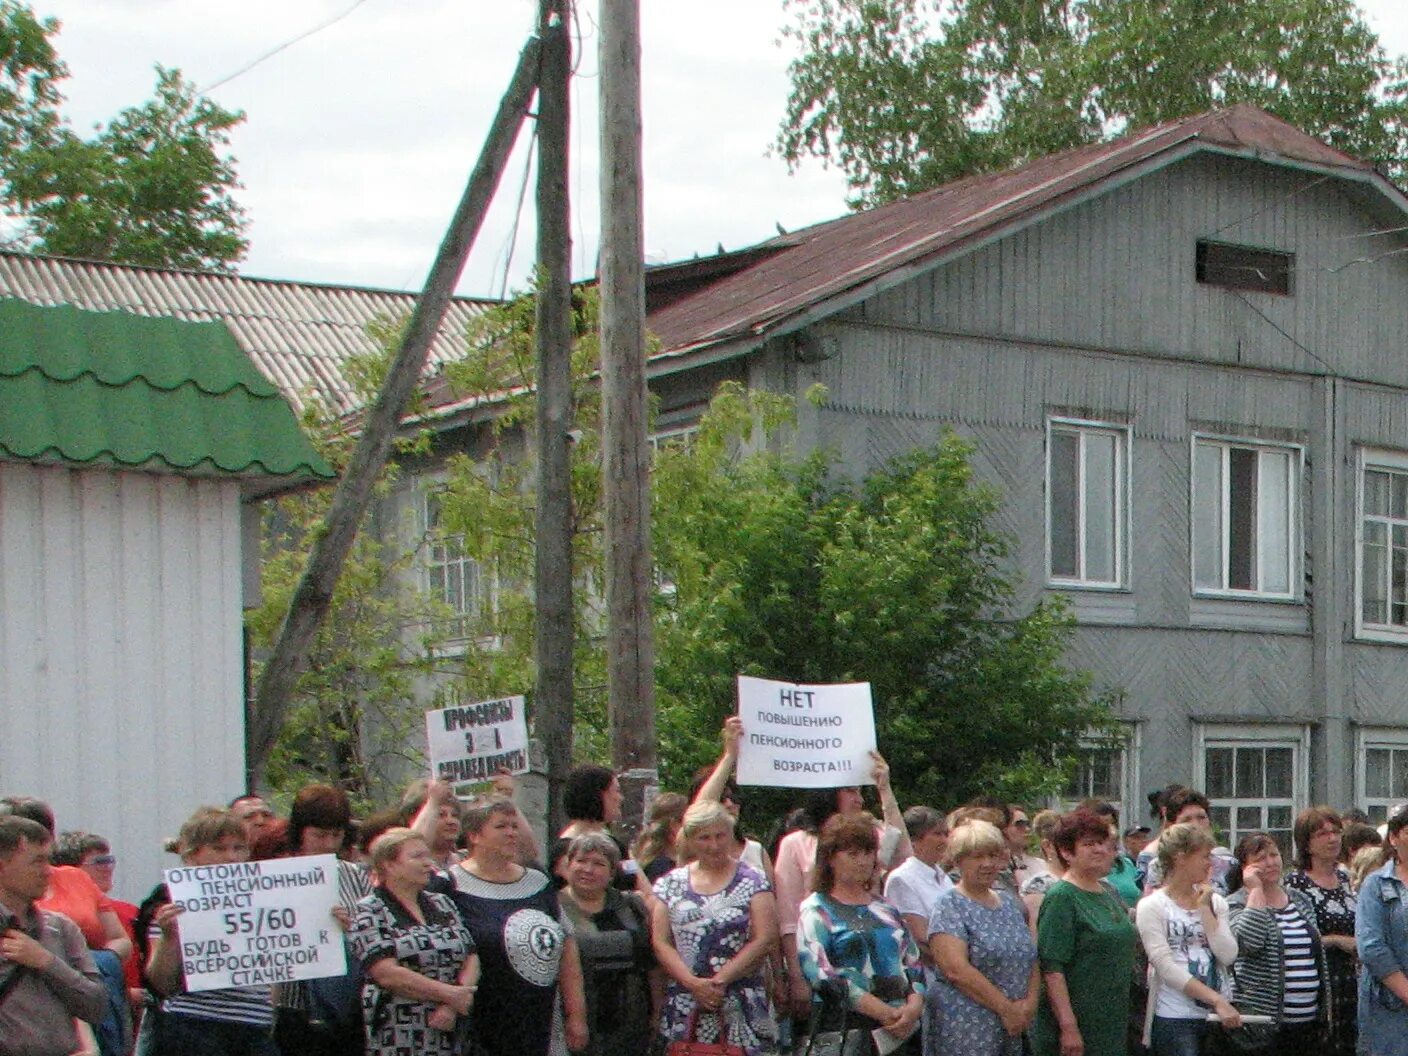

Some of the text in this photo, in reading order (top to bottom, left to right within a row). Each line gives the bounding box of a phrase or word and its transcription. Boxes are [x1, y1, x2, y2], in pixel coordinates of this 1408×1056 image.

[780, 689, 815, 708] НЕТ
[757, 711, 843, 727] ПОВЫШЕНИЮ
[750, 733, 842, 750] ПЕНСИОННОГО
[773, 759, 852, 773] ВОЗРАСТА!!!
[169, 863, 261, 884] ОТСТОИМ
[201, 866, 325, 896] ПЕНСИОННЫЙ
[175, 893, 253, 913] ВОЗРАСТ
[224, 907, 296, 937] 55/60
[183, 930, 329, 957] БУДЬ ГОТОВ К
[231, 966, 296, 986] СТАЧКЕ
